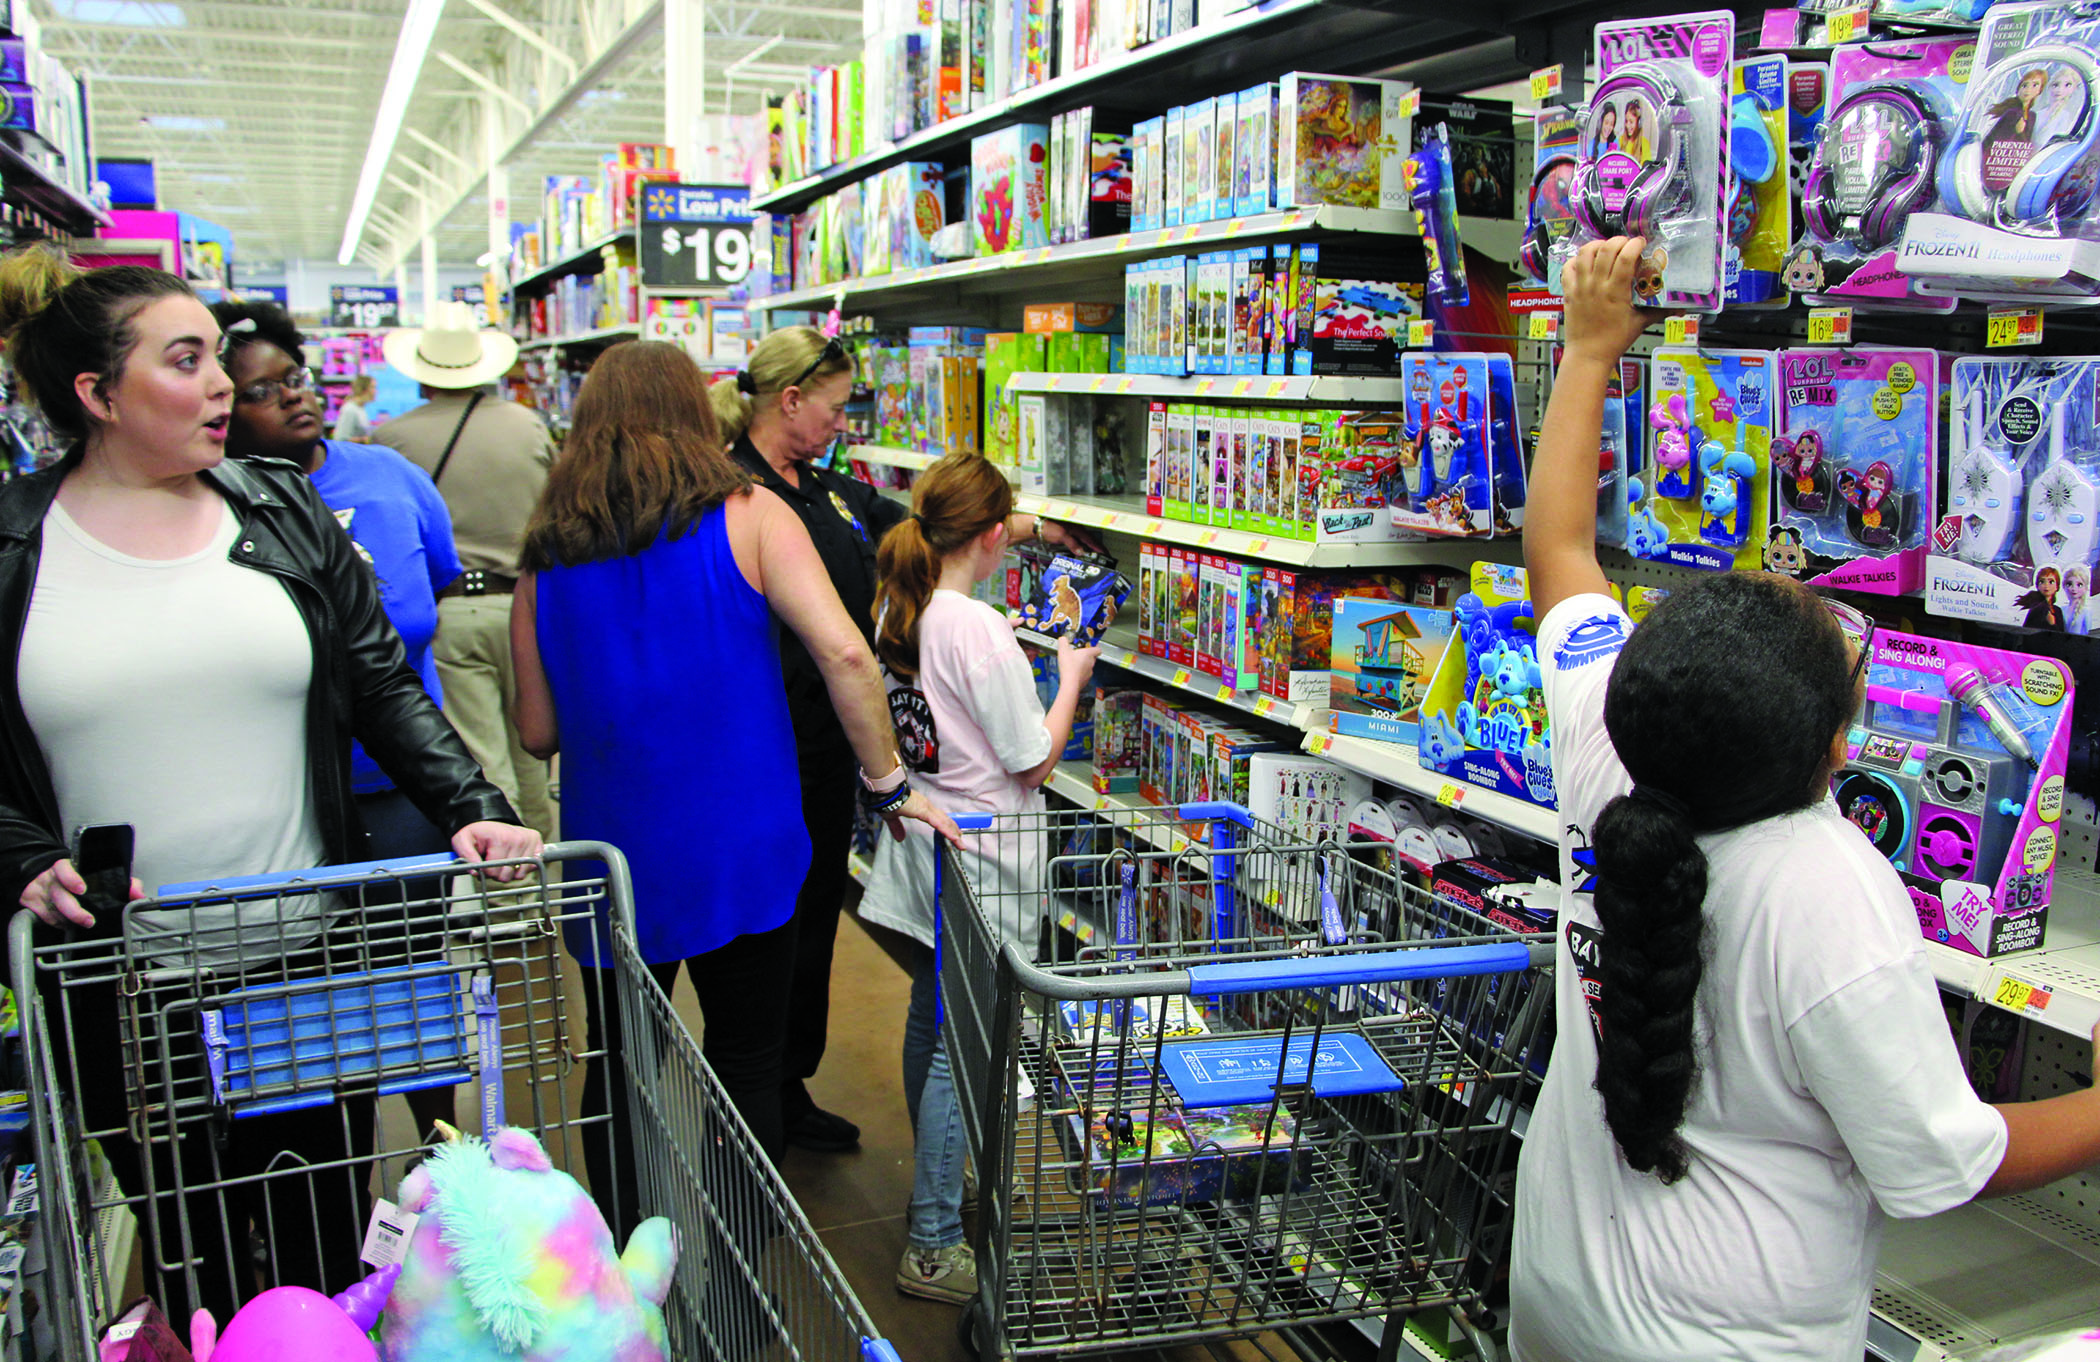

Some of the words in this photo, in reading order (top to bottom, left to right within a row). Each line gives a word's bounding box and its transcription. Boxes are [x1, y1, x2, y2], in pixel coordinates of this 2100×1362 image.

[1998, 23, 2024, 31] GREAT
[1989, 149, 2030, 158] VOLUME
[1991, 141, 2033, 150] PARENTAL
[1986, 157, 2027, 166] LIMITER
[679, 197, 719, 216] Low
[1904, 240, 1964, 257] FROZEN
[1988, 248, 2062, 264] Headphones
[1853, 271, 1907, 287] HEADPHONES
[1510, 298, 1564, 308] HEADPHONE
[1348, 327, 1374, 338] Perfect
[1325, 514, 1344, 528] Back
[1351, 515, 1371, 529] Past
[1940, 520, 1954, 538] TRY
[1944, 526, 1959, 548] ME!
[1671, 550, 1694, 563] Walkie
[1696, 554, 1721, 569] Talkies
[1829, 574, 1861, 585] WALKIE
[1862, 571, 1897, 582] TALKIES
[1933, 577, 1984, 595] FROZEN
[1930, 594, 1954, 606] Lights
[1955, 599, 1970, 607] and
[1970, 600, 1999, 611] Sounds
[1942, 605, 1963, 614] Walkie
[1964, 607, 1987, 617] Talkies
[1887, 638, 1927, 654] RECORD
[1929, 646, 1939, 656] &
[1878, 648, 1903, 662] SING
[1904, 653, 1946, 670] ALONG!
[2030, 667, 2058, 678] TURNTABLE
[2024, 678, 2063, 692] SCRATCHING
[2025, 685, 2049, 696] SOUND
[1368, 722, 1399, 734] MIAMI
[1480, 720, 1529, 756] BLUE!
[1464, 761, 1500, 780] SING-ALONG
[1527, 759, 1553, 778] Blue's
[1527, 771, 1552, 790] Clues
[2042, 785, 2062, 794] RECORD
[2048, 793, 2060, 802] SING
[2026, 846, 2037, 854] ANY
[2038, 844, 2054, 853] MUSIC
[2029, 836, 2053, 846] CONNECT
[1961, 886, 1989, 917] TRY
[1950, 901, 1980, 931] ME!
[2002, 919, 2030, 933] RECORD
[2030, 918, 2037, 926] &
[1996, 926, 2040, 944] SING-ALONG
[1998, 937, 2036, 953] BOOMBOX
[481, 1033, 489, 1050] seat
[490, 1044, 499, 1069] Always
[485, 1082, 497, 1134] Walmart
